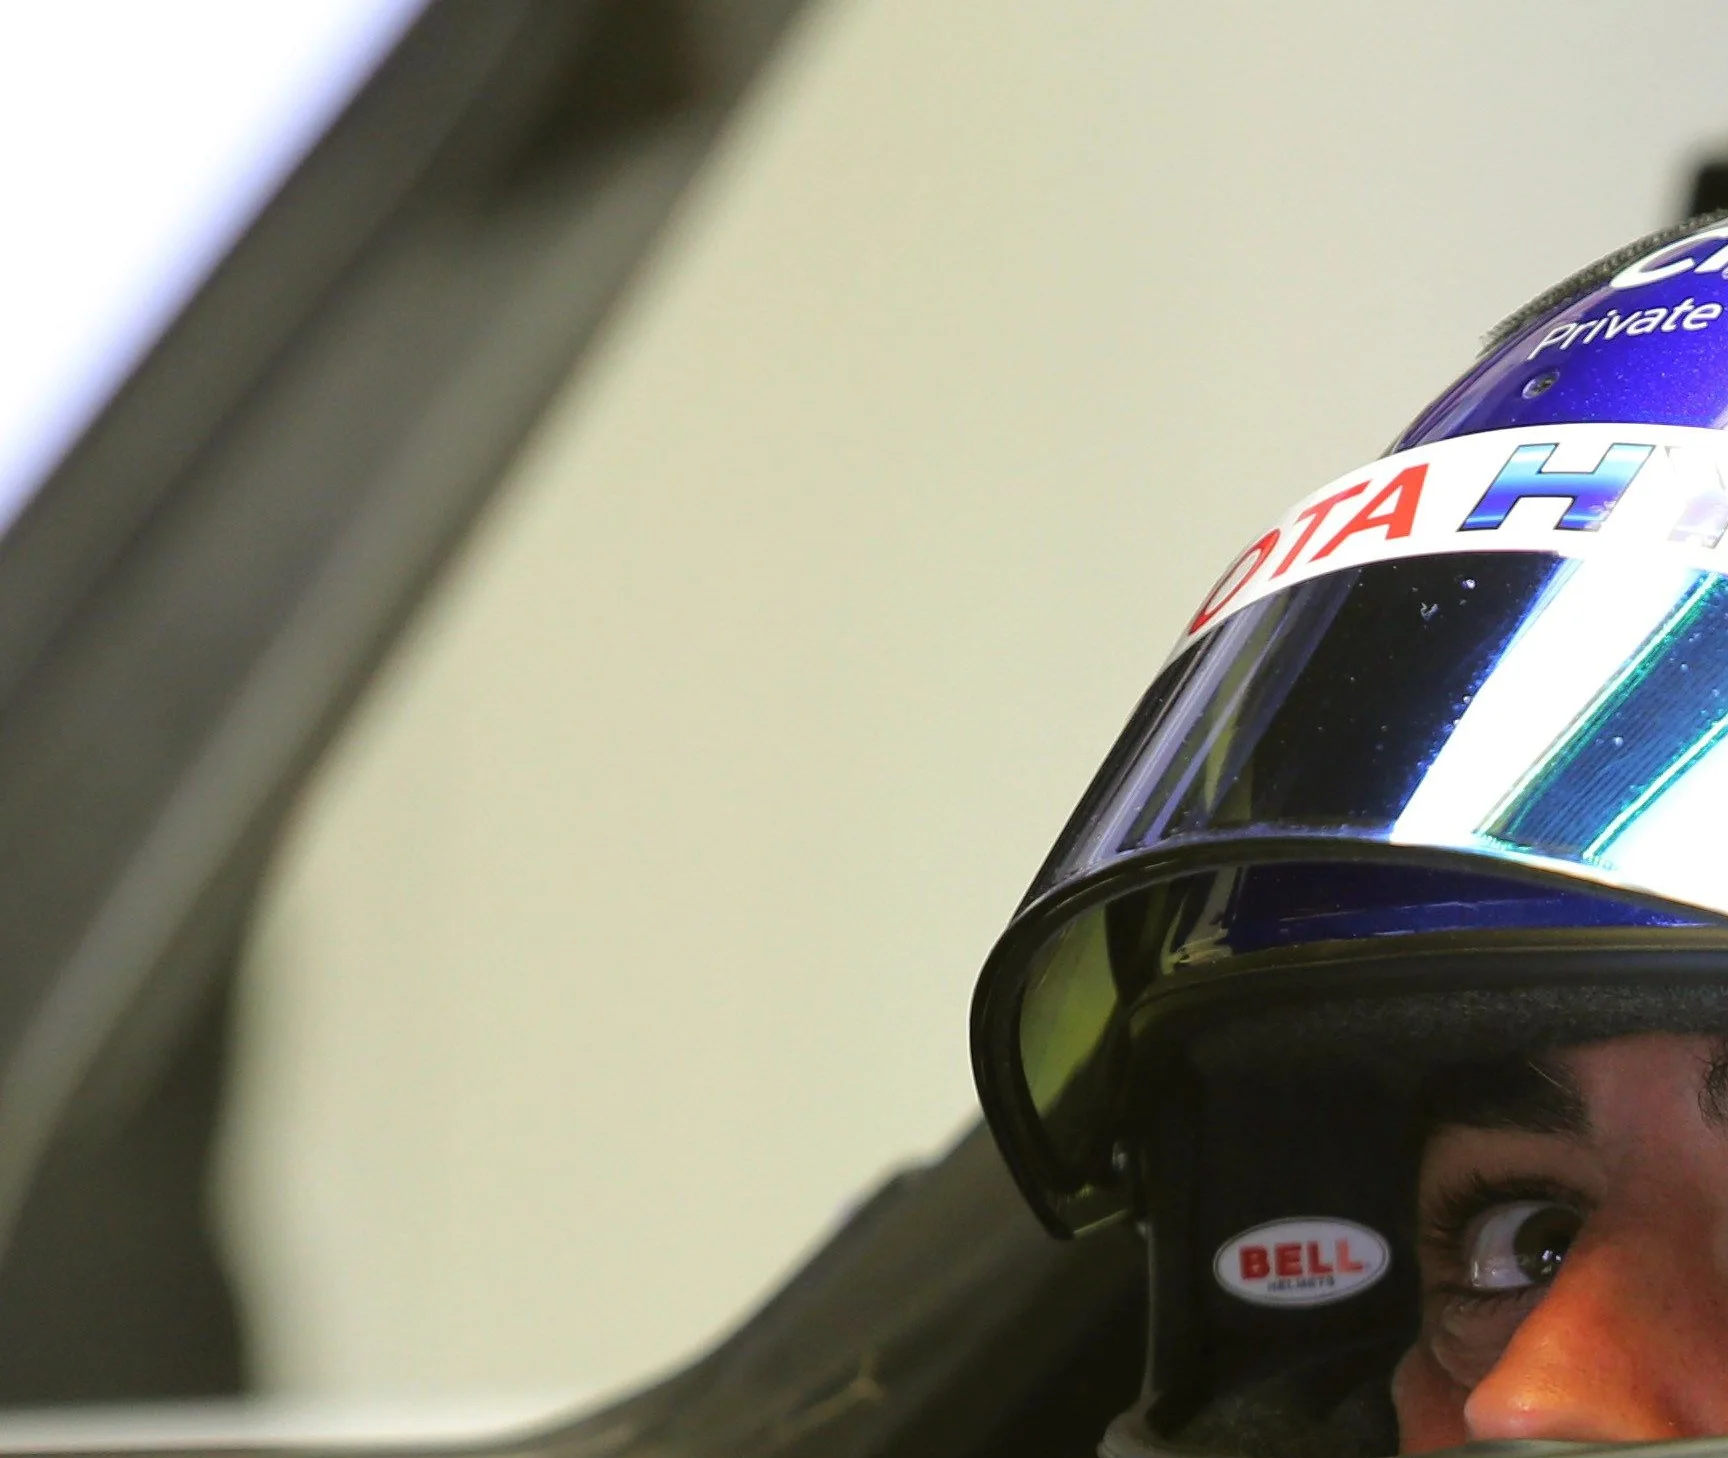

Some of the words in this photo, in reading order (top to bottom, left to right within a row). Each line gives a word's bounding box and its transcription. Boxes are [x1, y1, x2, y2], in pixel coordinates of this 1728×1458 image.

[1527, 298, 1722, 361] Private
[1188, 462, 1430, 636] OTA
[1239, 1236, 1363, 1281] BELL
